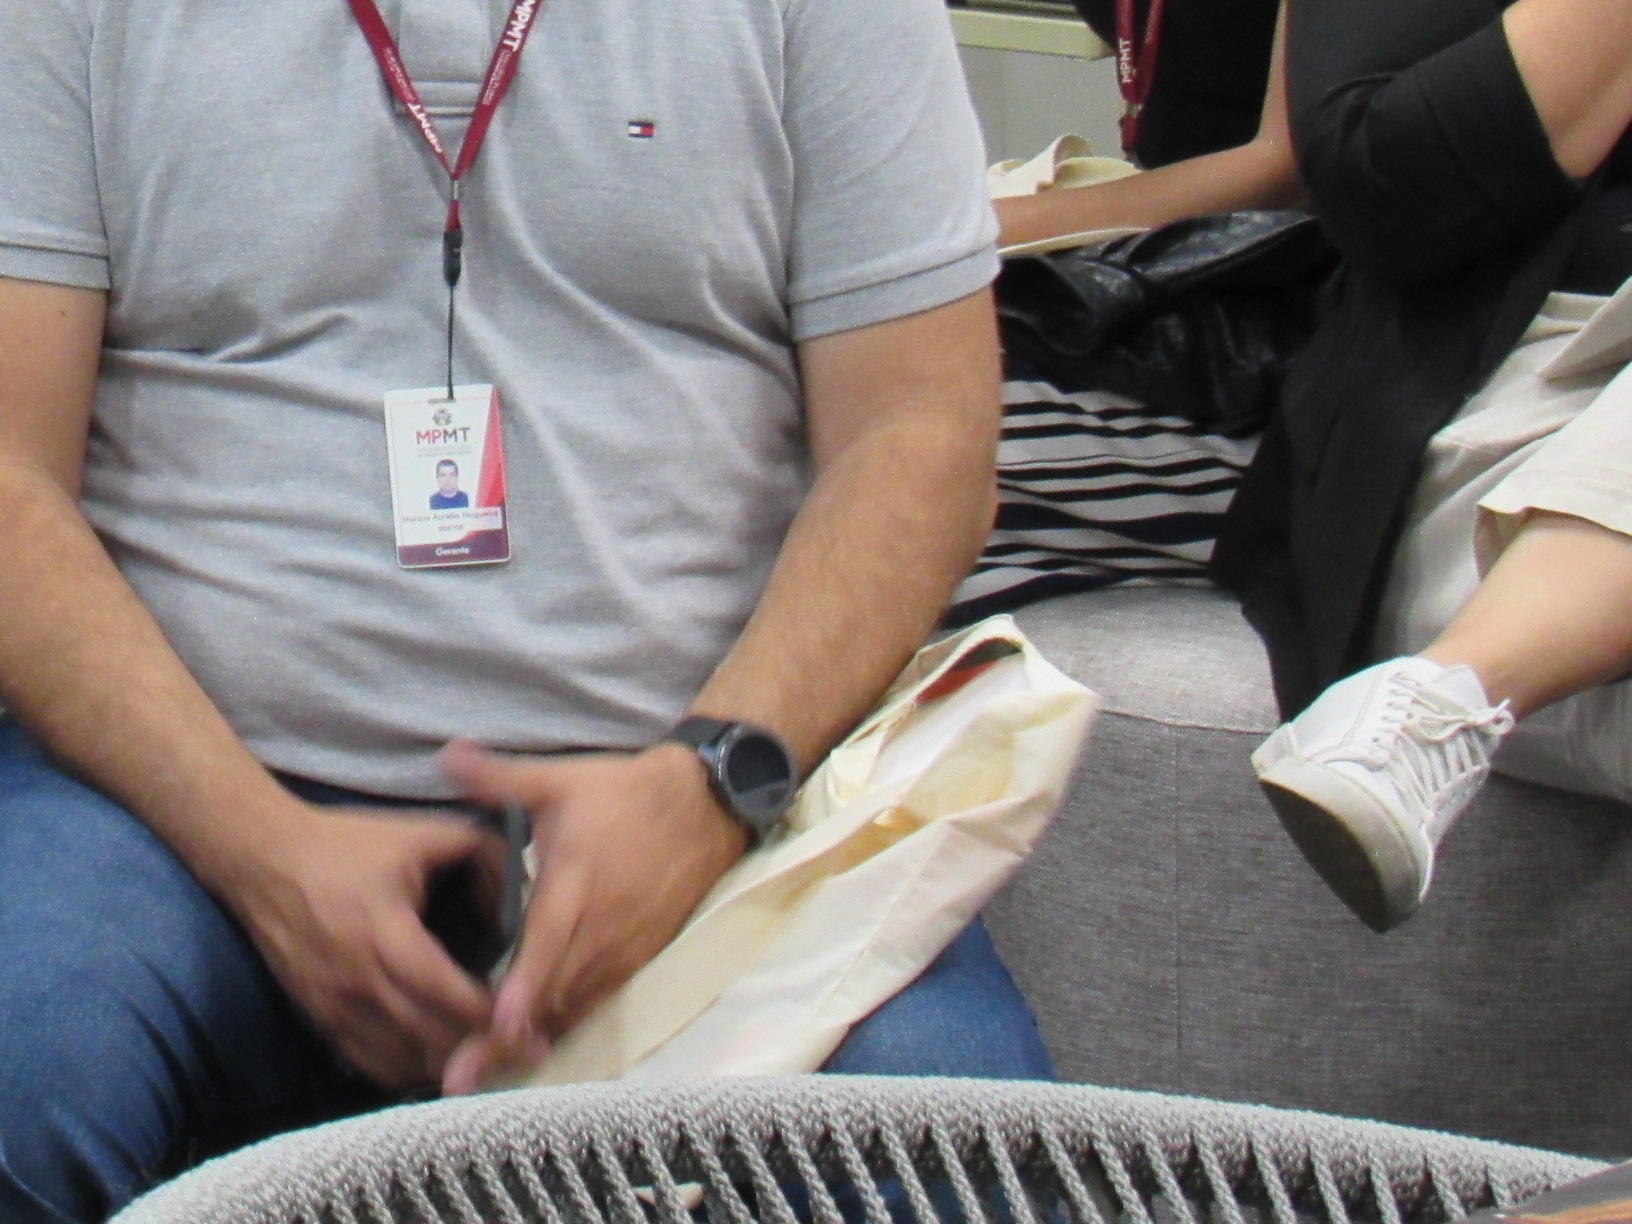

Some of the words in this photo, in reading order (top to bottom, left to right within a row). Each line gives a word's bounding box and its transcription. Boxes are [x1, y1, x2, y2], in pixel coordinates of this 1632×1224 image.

[1119, 36, 1134, 84] MPMT
[415, 426, 471, 445] MPMT
[435, 546, 470, 557] Gerente
